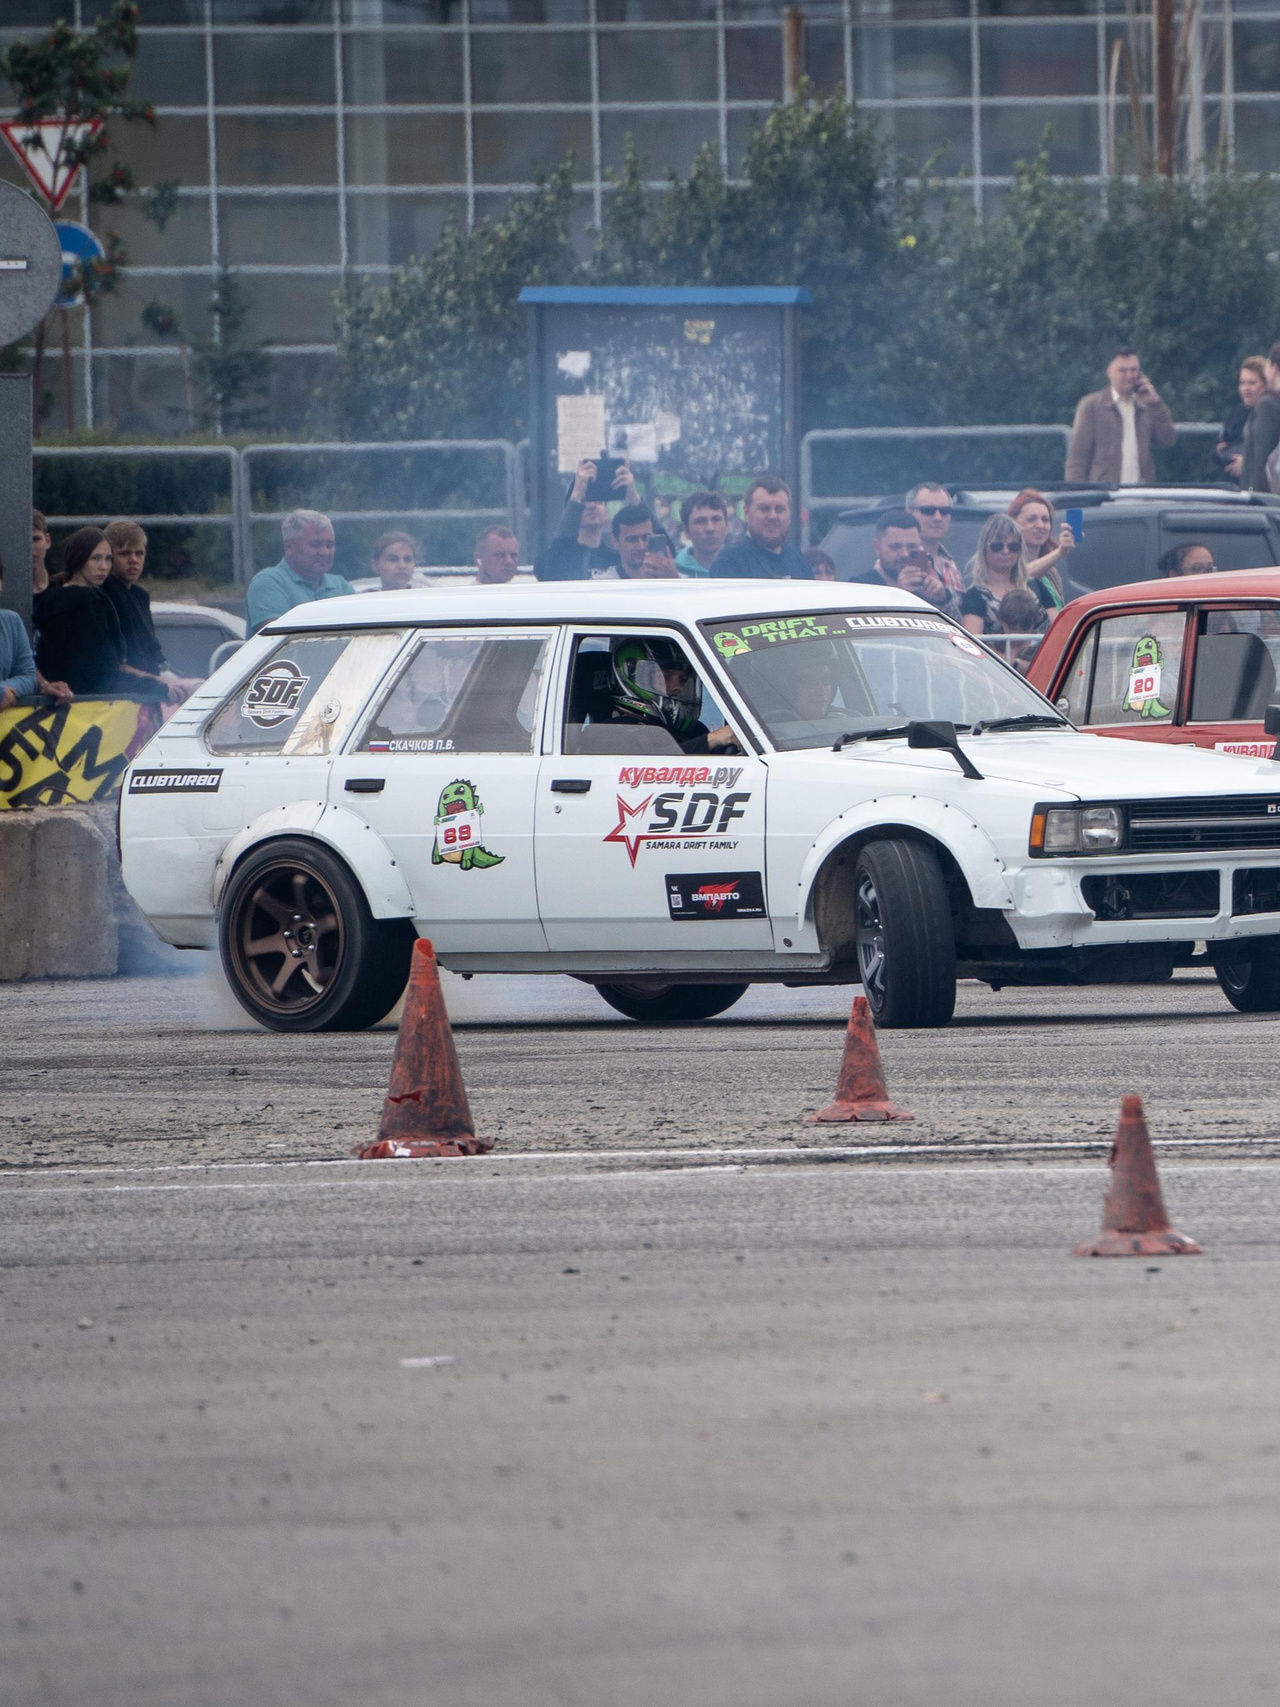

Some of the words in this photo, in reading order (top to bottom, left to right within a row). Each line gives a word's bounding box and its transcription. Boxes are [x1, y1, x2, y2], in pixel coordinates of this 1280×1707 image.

[741, 617, 816, 637] DRIFT
[245, 677, 306, 705] SDF
[1133, 677, 1154, 694] 20
[389, 740, 434, 751] СКАЧКОВ
[435, 739, 455, 750] П.В.
[131, 775, 220, 787] CLUBTURBO
[618, 766, 744, 788] кувалда.ру
[648, 792, 752, 833] SDF
[444, 824, 471, 845] 88
[645, 841, 681, 850] SAMARA
[683, 841, 707, 850] DRIFT
[709, 841, 739, 850] FAMILY
[691, 892, 740, 902] ВМПАВТО
